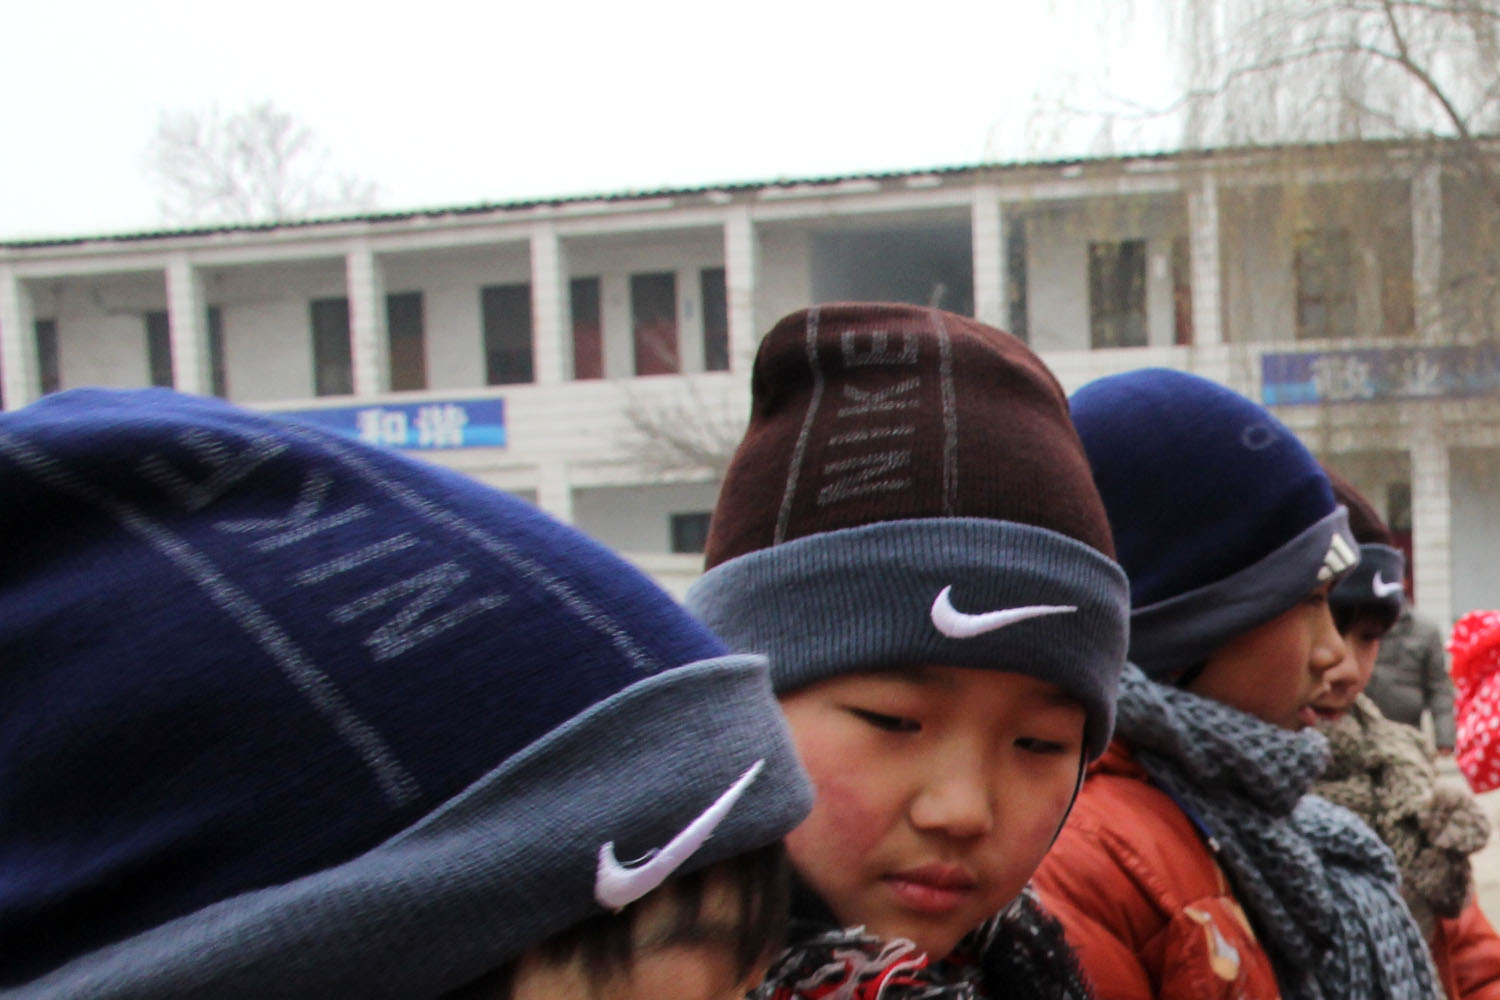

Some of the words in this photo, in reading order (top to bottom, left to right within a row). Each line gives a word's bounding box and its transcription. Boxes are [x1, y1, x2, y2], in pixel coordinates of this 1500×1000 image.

[355, 403, 470, 448] 和谐
[817, 330, 920, 507] NIKE
[137, 427, 511, 663] NIKE
